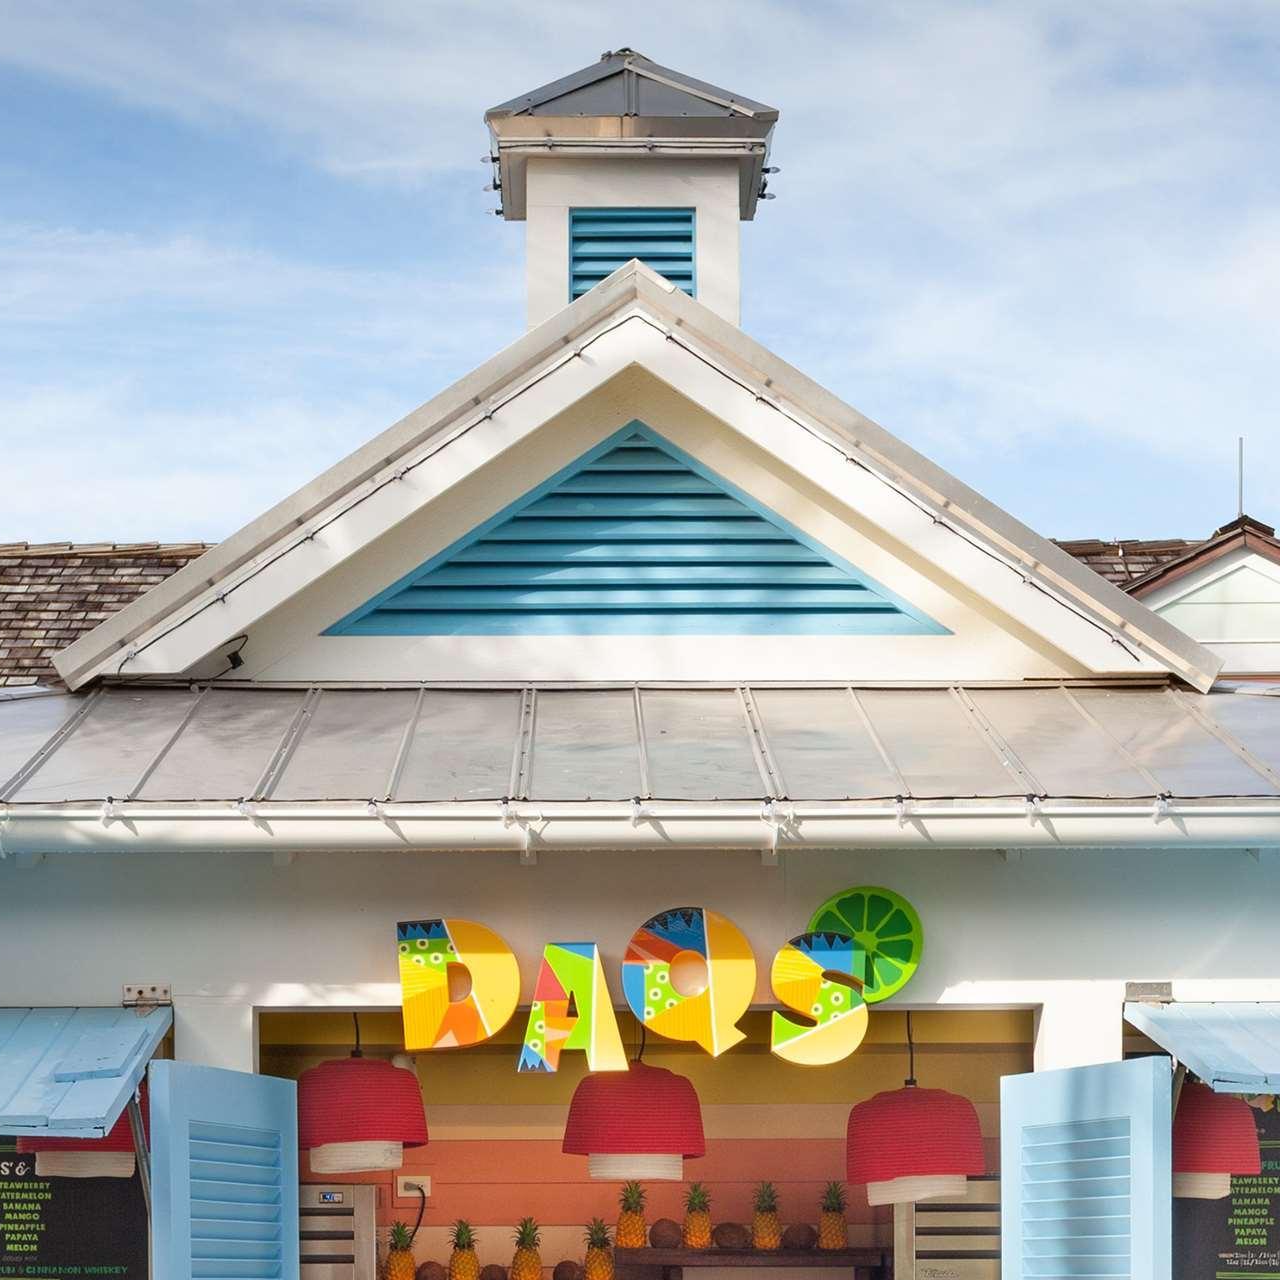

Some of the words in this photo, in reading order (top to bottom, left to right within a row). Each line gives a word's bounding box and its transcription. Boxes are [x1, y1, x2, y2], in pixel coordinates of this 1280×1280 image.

[396, 906, 869, 1072] DAQS
[2, 1202, 42, 1210] BANANA
[1231, 1198, 1271, 1206] BANANA
[4, 1212, 40, 1220] MANGO
[1233, 1208, 1269, 1216] MANGO
[1227, 1218, 1275, 1226] PINEAPPLE
[1234, 1228, 1268, 1236] PAPAYA
[4, 1233, 39, 1241] PAPAYA
[1235, 1238, 1267, 1246] MELON
[5, 1244, 38, 1252] MELON
